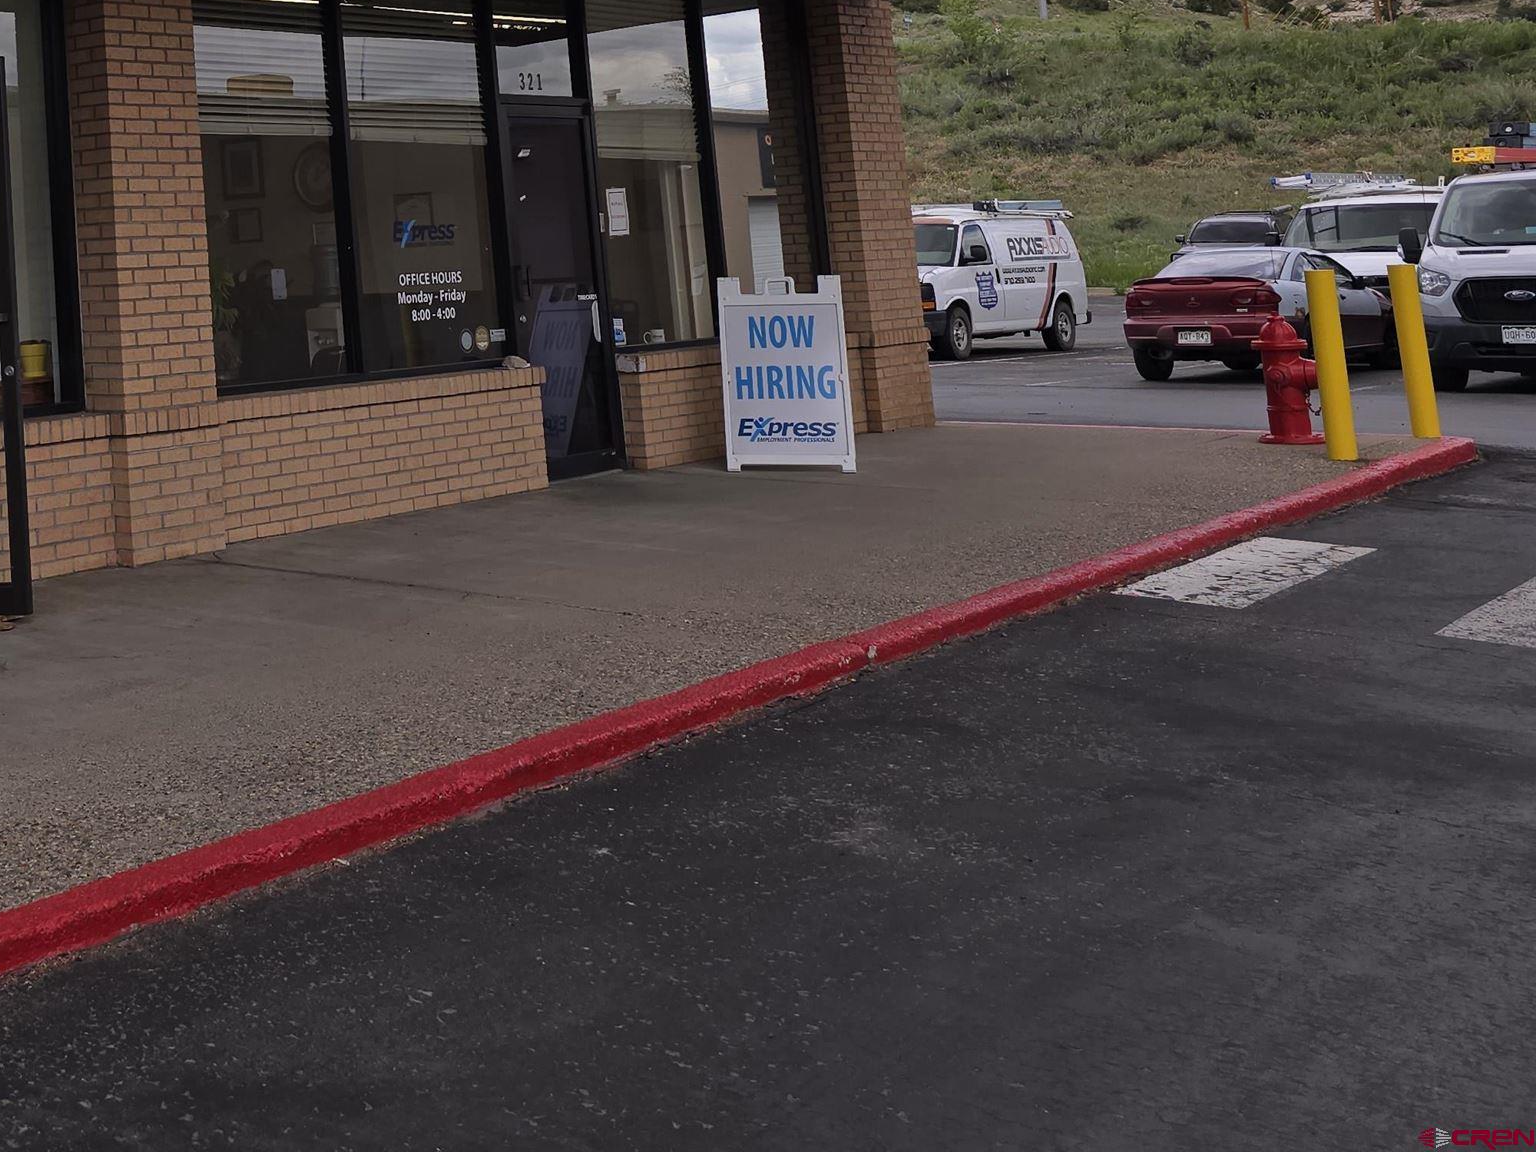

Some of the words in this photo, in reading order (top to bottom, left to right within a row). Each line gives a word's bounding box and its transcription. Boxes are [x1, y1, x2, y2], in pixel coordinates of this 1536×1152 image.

[519, 72, 543, 91] 321
[393, 219, 455, 248] Express
[398, 272, 430, 286] OFFICE
[431, 270, 462, 285] HOURS
[397, 291, 433, 305] Monday
[439, 289, 467, 304] Friday
[411, 308, 431, 322] 8:00
[436, 307, 456, 320] 4:00
[748, 315, 814, 349] NOW
[735, 365, 836, 400] HIRING
[737, 416, 837, 442] Express
